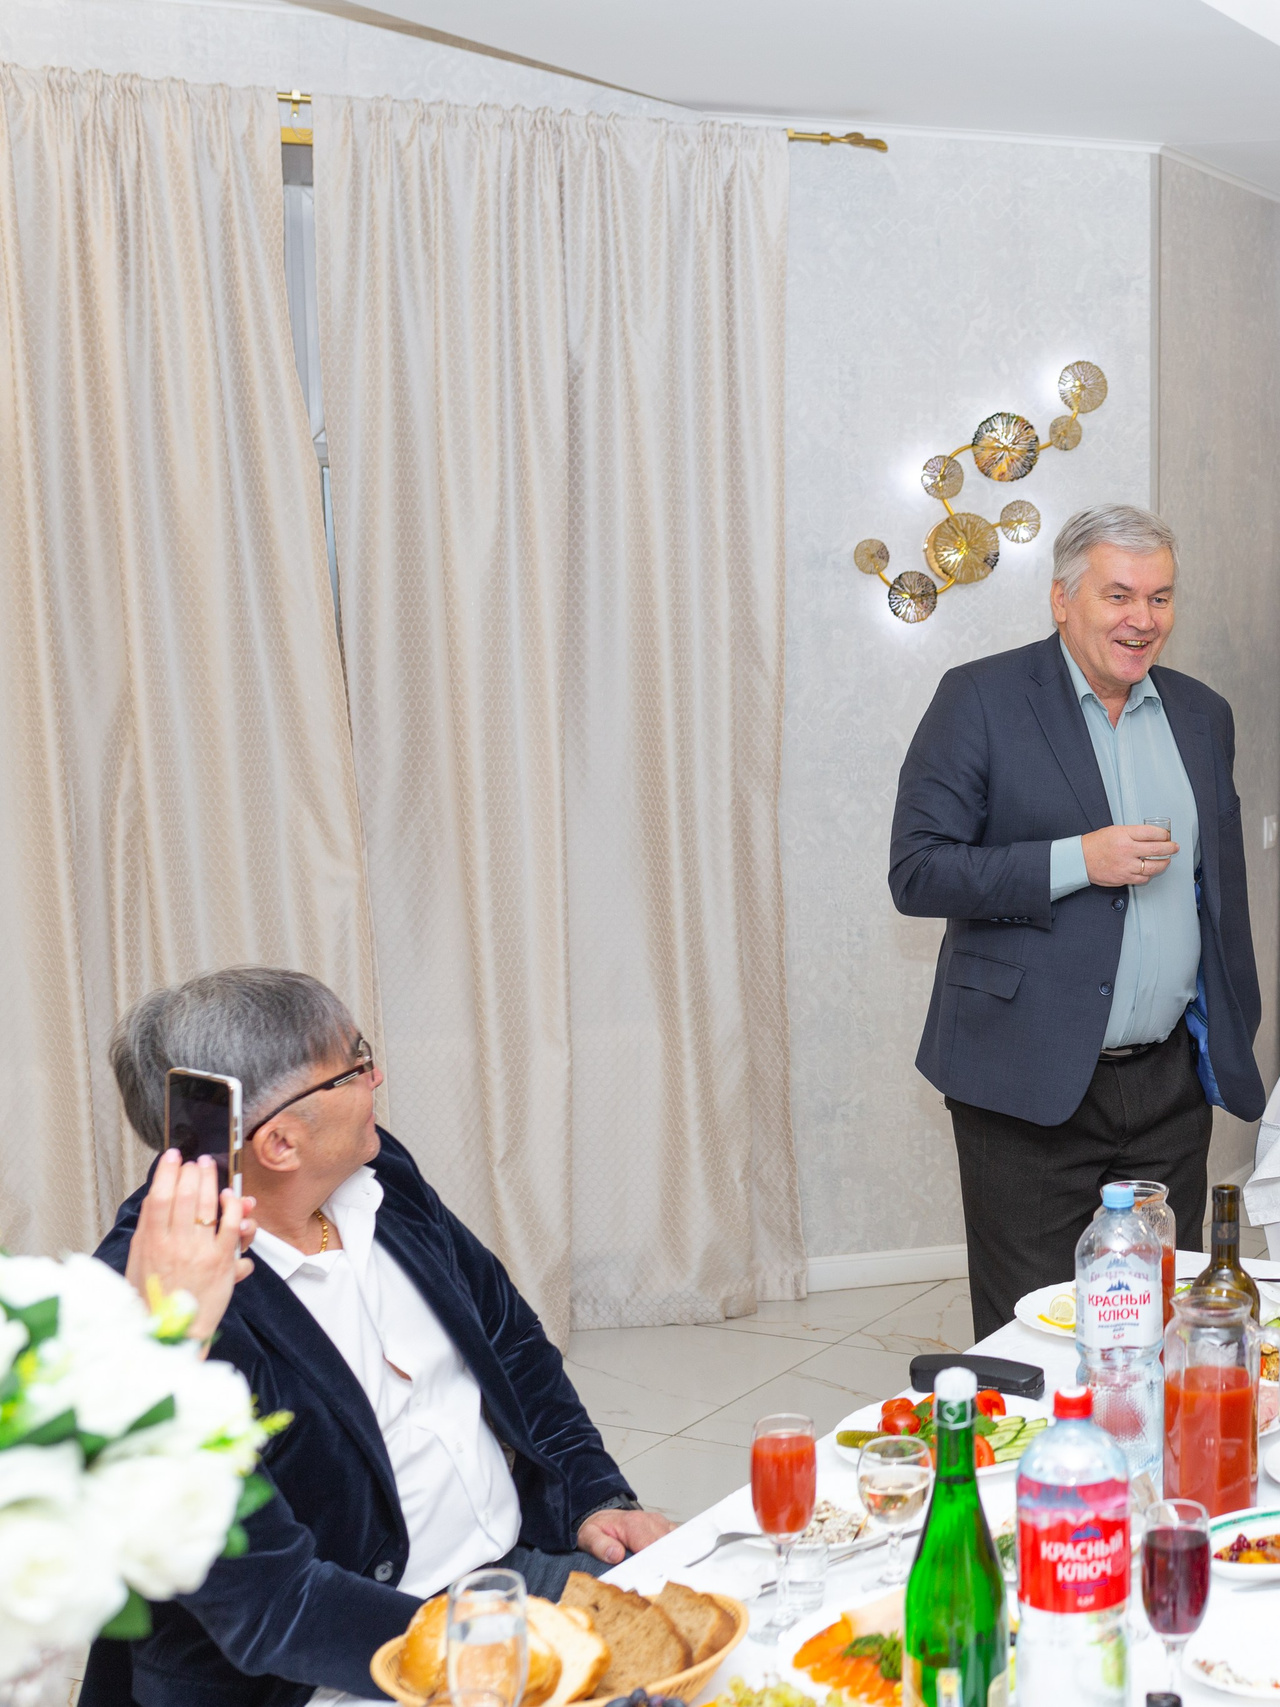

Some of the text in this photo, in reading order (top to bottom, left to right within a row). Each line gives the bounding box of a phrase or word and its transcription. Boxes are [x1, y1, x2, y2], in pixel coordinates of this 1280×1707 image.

[1088, 1290, 1151, 1307] КРАСНЫЙ
[1098, 1308, 1139, 1322] КЛЮЧ
[1040, 1528, 1124, 1562] КРАСНЫЙ
[1056, 1557, 1112, 1582] КЛЮЧ
